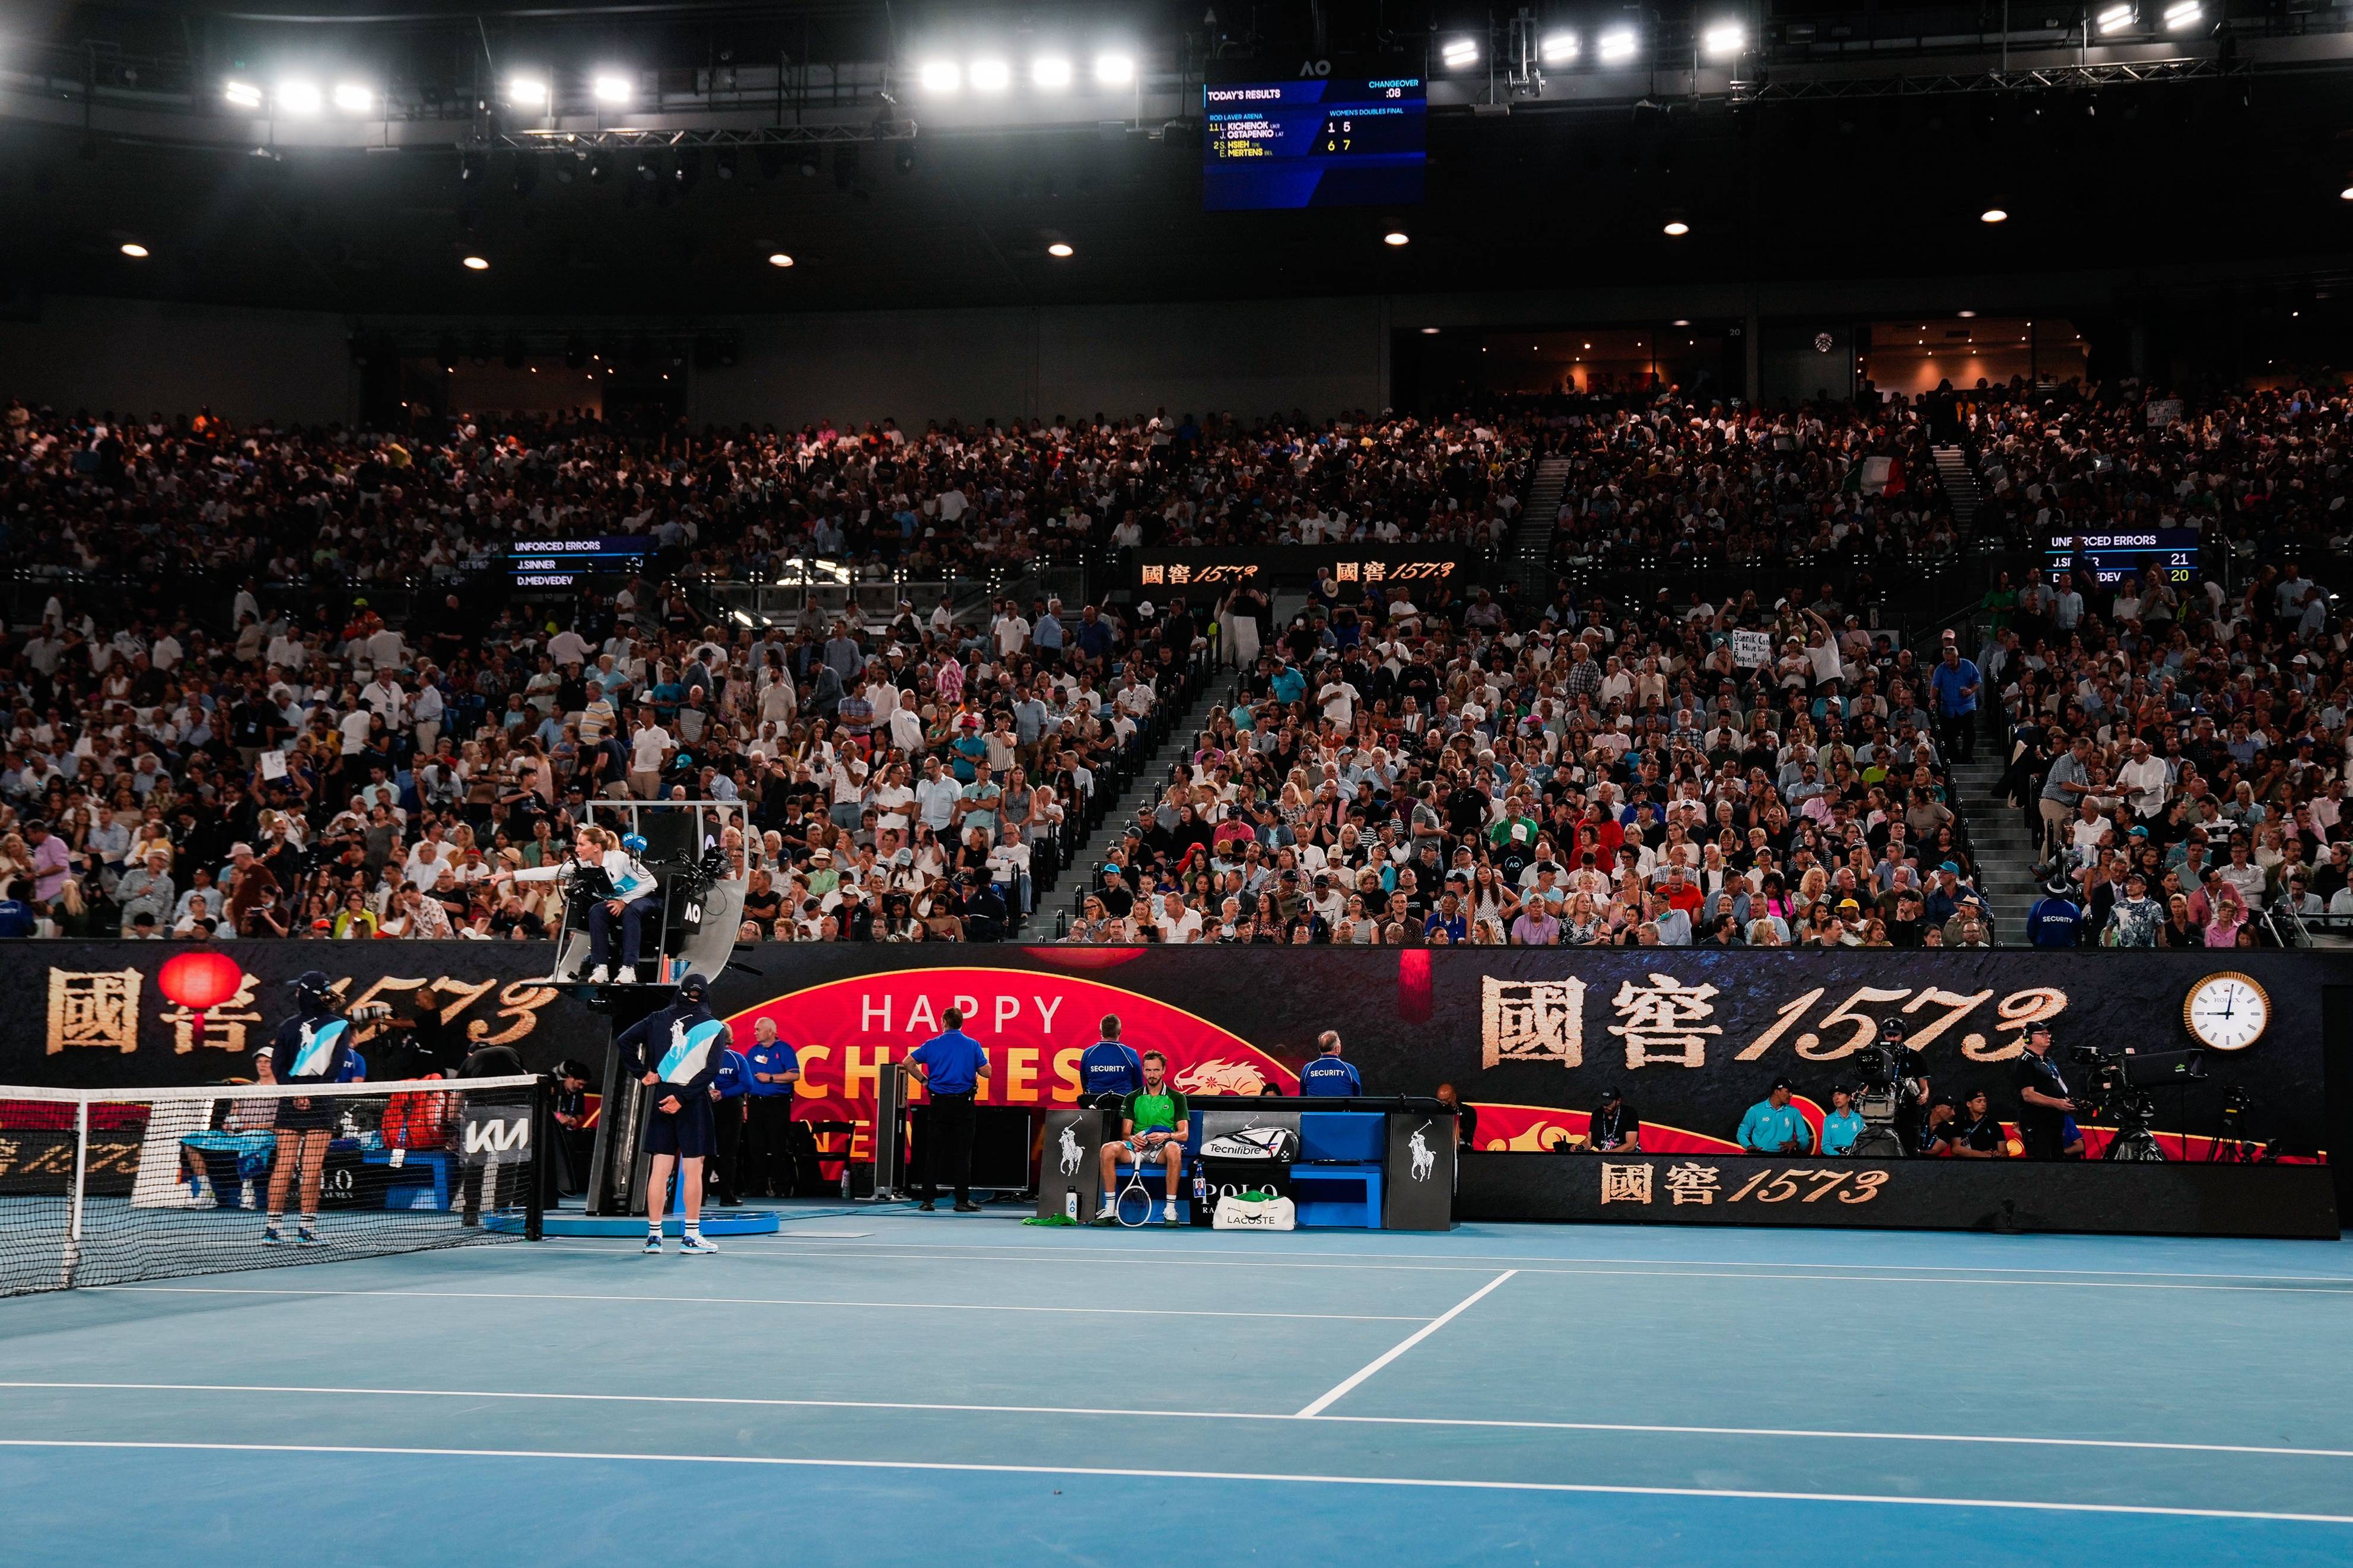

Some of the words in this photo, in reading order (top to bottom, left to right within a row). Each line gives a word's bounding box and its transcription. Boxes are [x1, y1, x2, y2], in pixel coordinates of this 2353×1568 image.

[1369, 79, 1419, 88] CHANGEOVER
[1207, 90, 1245, 101] TODAY'S
[1245, 89, 1280, 100] RESULTS
[1386, 88, 1401, 98] :08
[1209, 123, 1219, 132] 11
[1228, 121, 1268, 131] KICHENOK
[1328, 122, 1335, 133] 1
[1343, 122, 1350, 132] 5
[1227, 129, 1274, 139] OSTAPENKO
[1214, 141, 1219, 150] 2
[1228, 140, 1249, 149] HSIEH
[1328, 140, 1336, 151] 6
[1343, 139, 1351, 151] 7
[1228, 148, 1263, 157] MERTENS
[515, 541, 564, 551] UNFORCED
[565, 540, 600, 551] ERRORS
[2052, 536, 2111, 546] UNFRCED
[2113, 535, 2157, 546] ERRORS
[517, 560, 556, 570] J.SINNER
[2171, 554, 2189, 565] 21
[1388, 561, 1455, 580] 1573
[2171, 570, 2189, 581] 20
[517, 576, 573, 586] D.MEDVEDEV
[603, 596, 615, 606] 10
[1743, 643, 1756, 652] Have
[684, 902, 701, 923] AO
[861, 994, 1063, 1033] HAPPY
[1735, 987, 2069, 1063] 1573
[1210, 1143, 1261, 1155] Tecnifibre
[1727, 1168, 1890, 1204] 1573
[1228, 1216, 1275, 1224] LACOSTE
